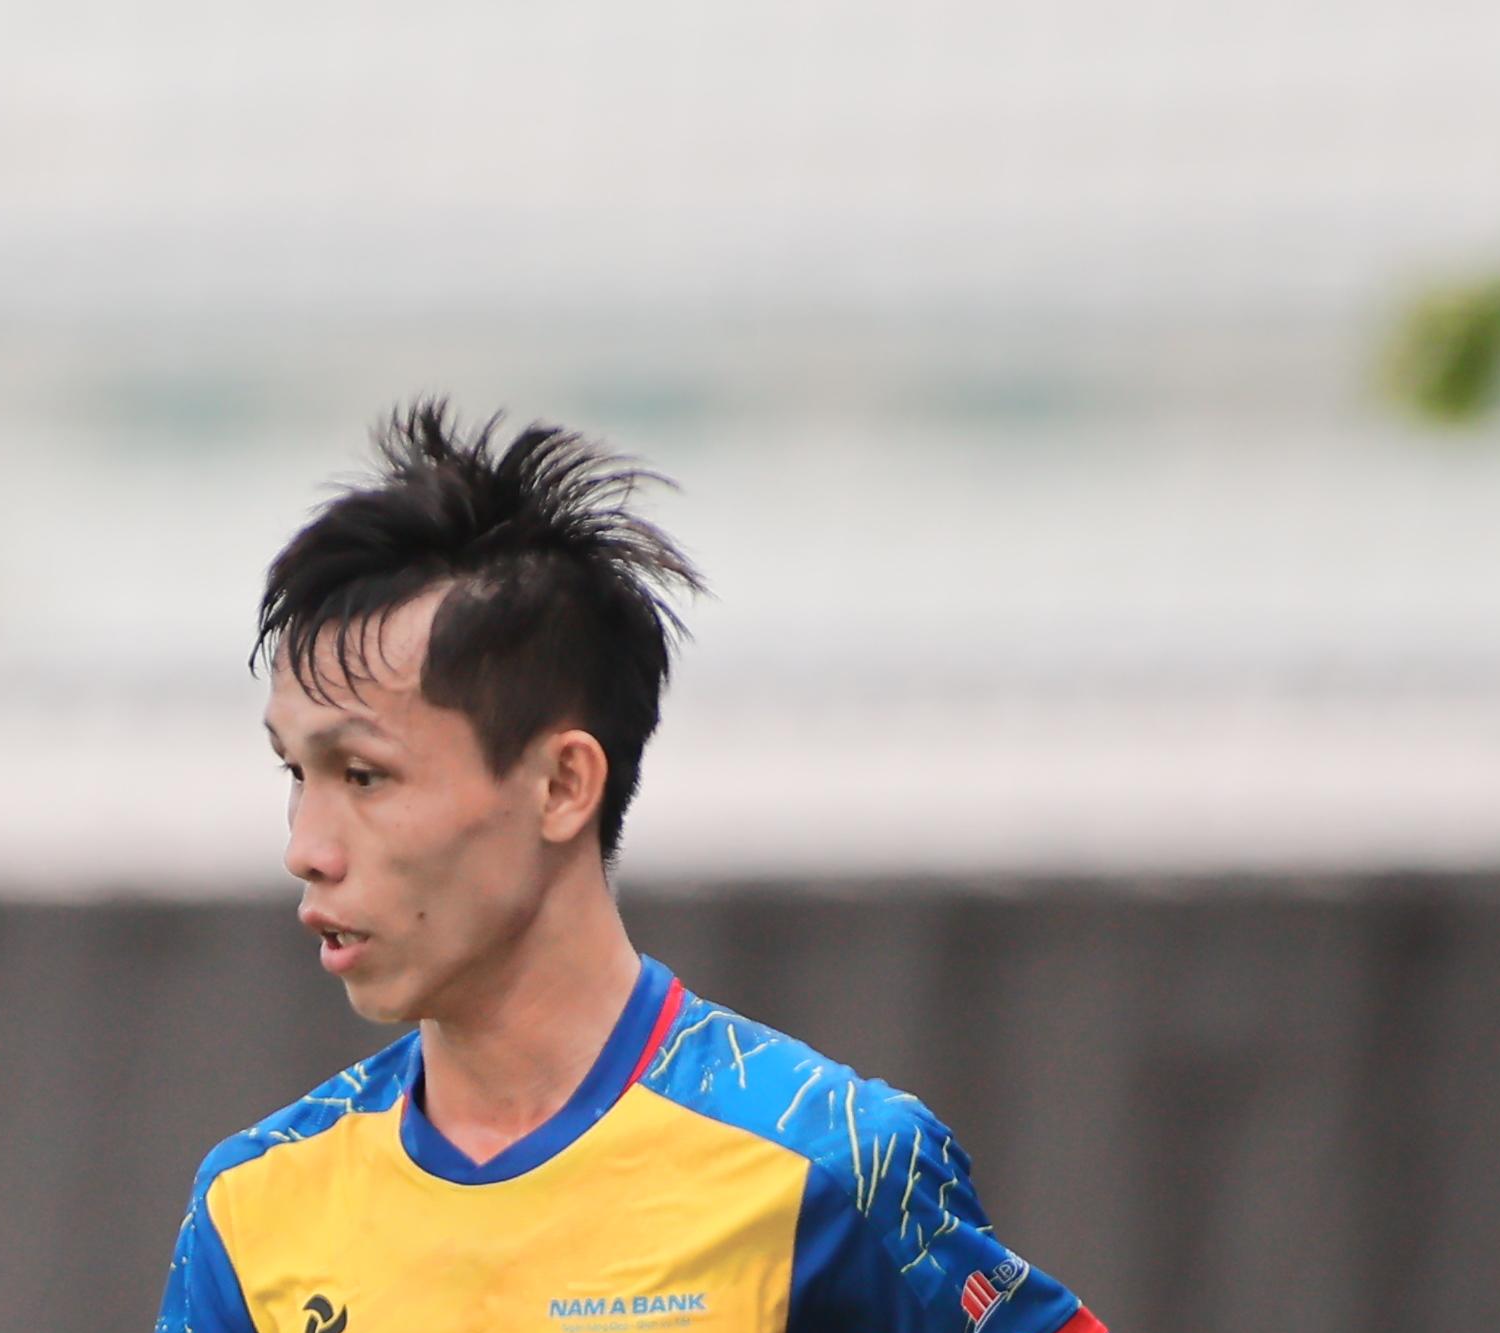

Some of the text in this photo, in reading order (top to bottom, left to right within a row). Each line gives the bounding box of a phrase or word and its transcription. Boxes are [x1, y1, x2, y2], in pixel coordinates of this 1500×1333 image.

[549, 1293, 707, 1317] NAM A BANK
